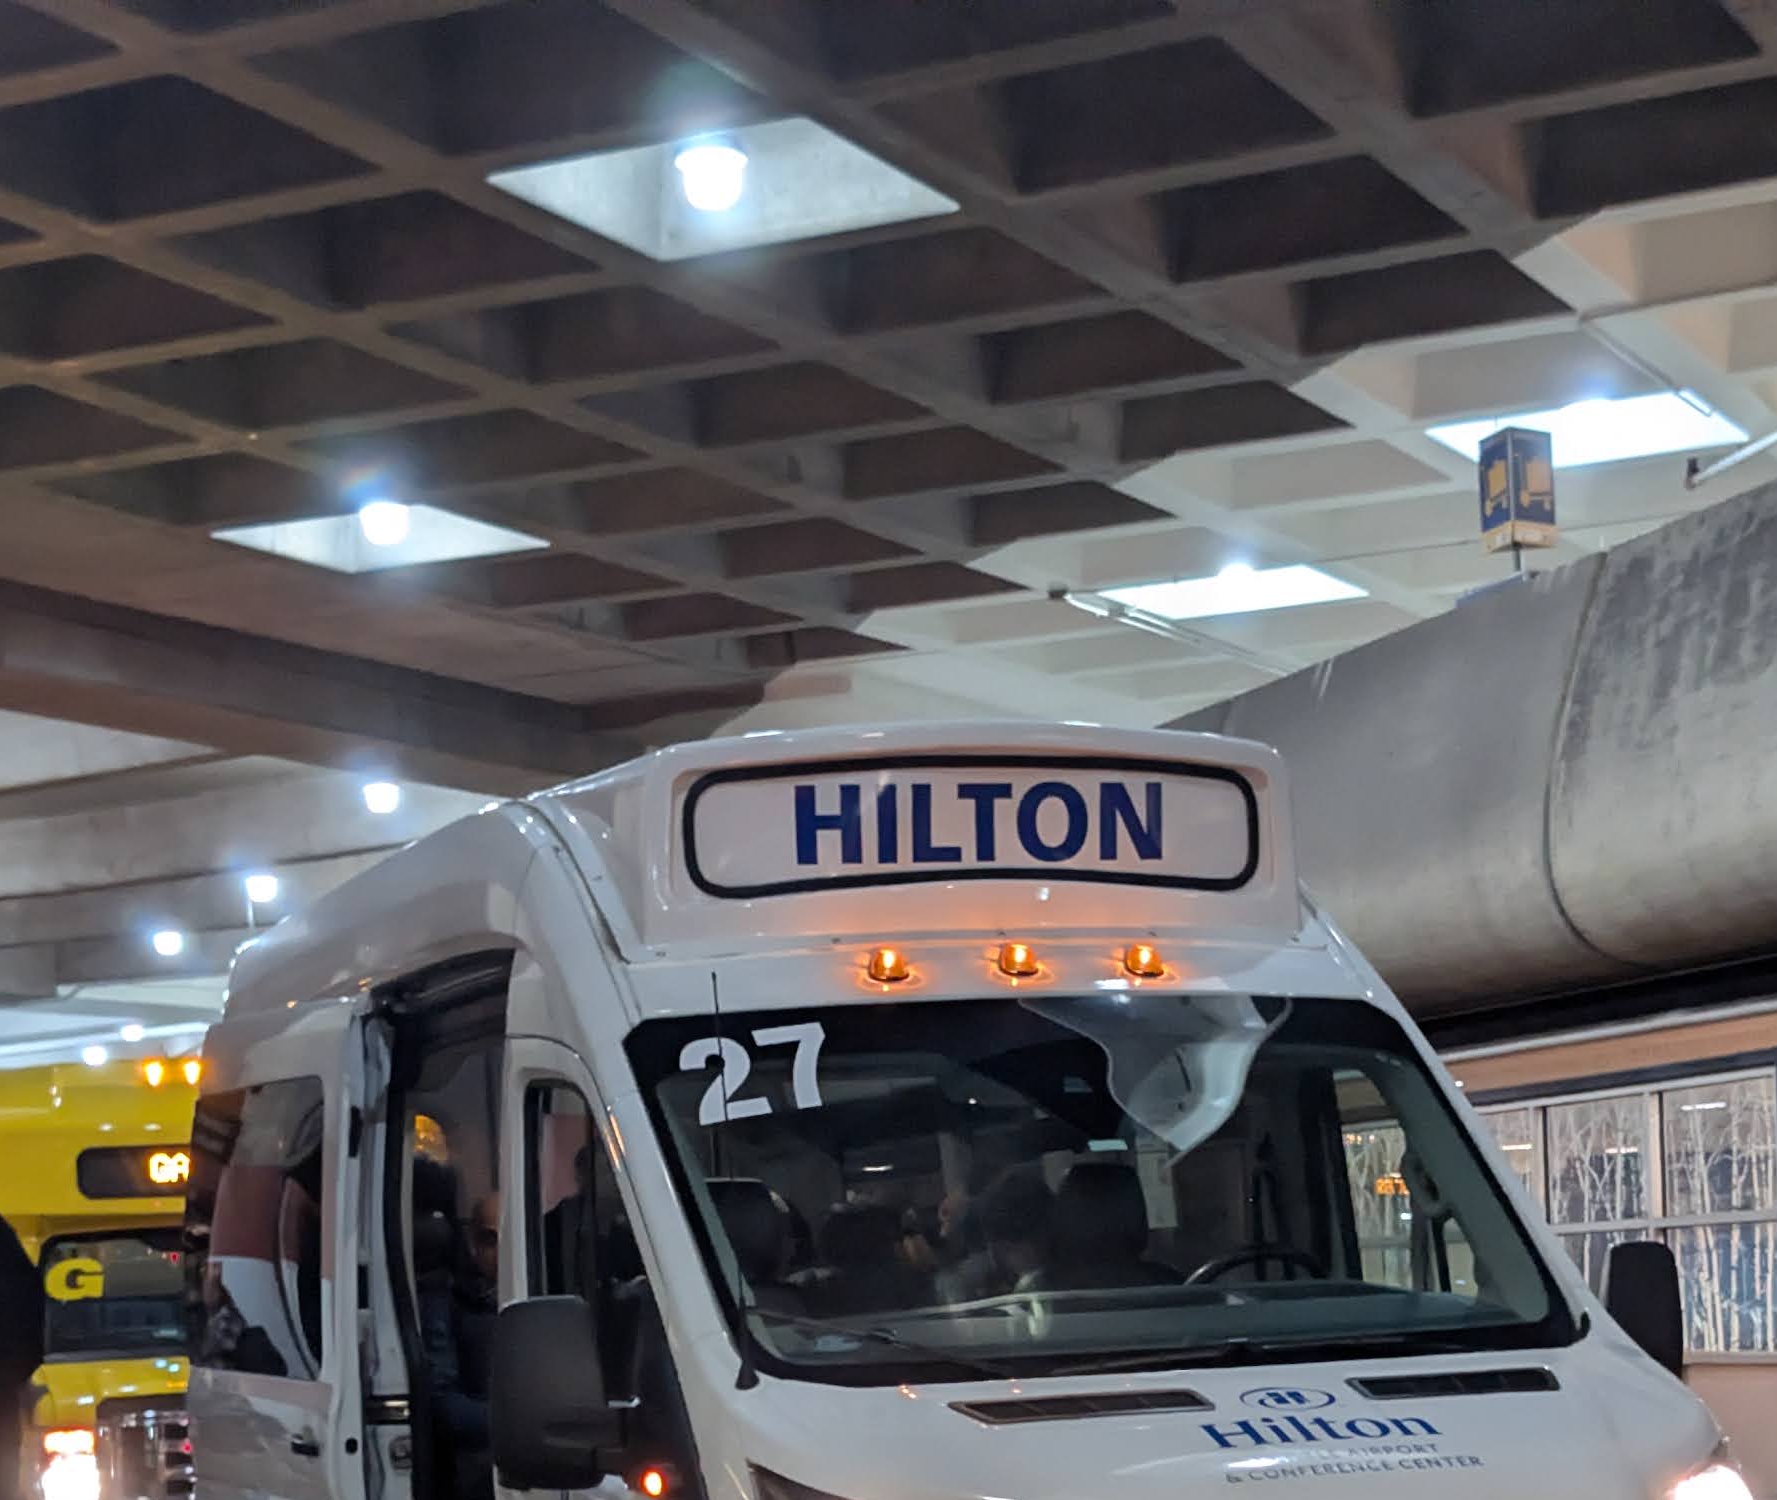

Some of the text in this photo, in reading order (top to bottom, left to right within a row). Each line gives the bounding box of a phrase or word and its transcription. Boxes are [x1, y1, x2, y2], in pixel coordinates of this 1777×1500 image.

[794, 781, 1163, 866] HILTON
[679, 1021, 826, 1126] 27
[45, 1257, 105, 1301] G
[1200, 1414, 1443, 1449] Hilton
[1347, 1442, 1439, 1457] AIRPORT
[1225, 1454, 1486, 1484] & CONFERENCE CENTER
